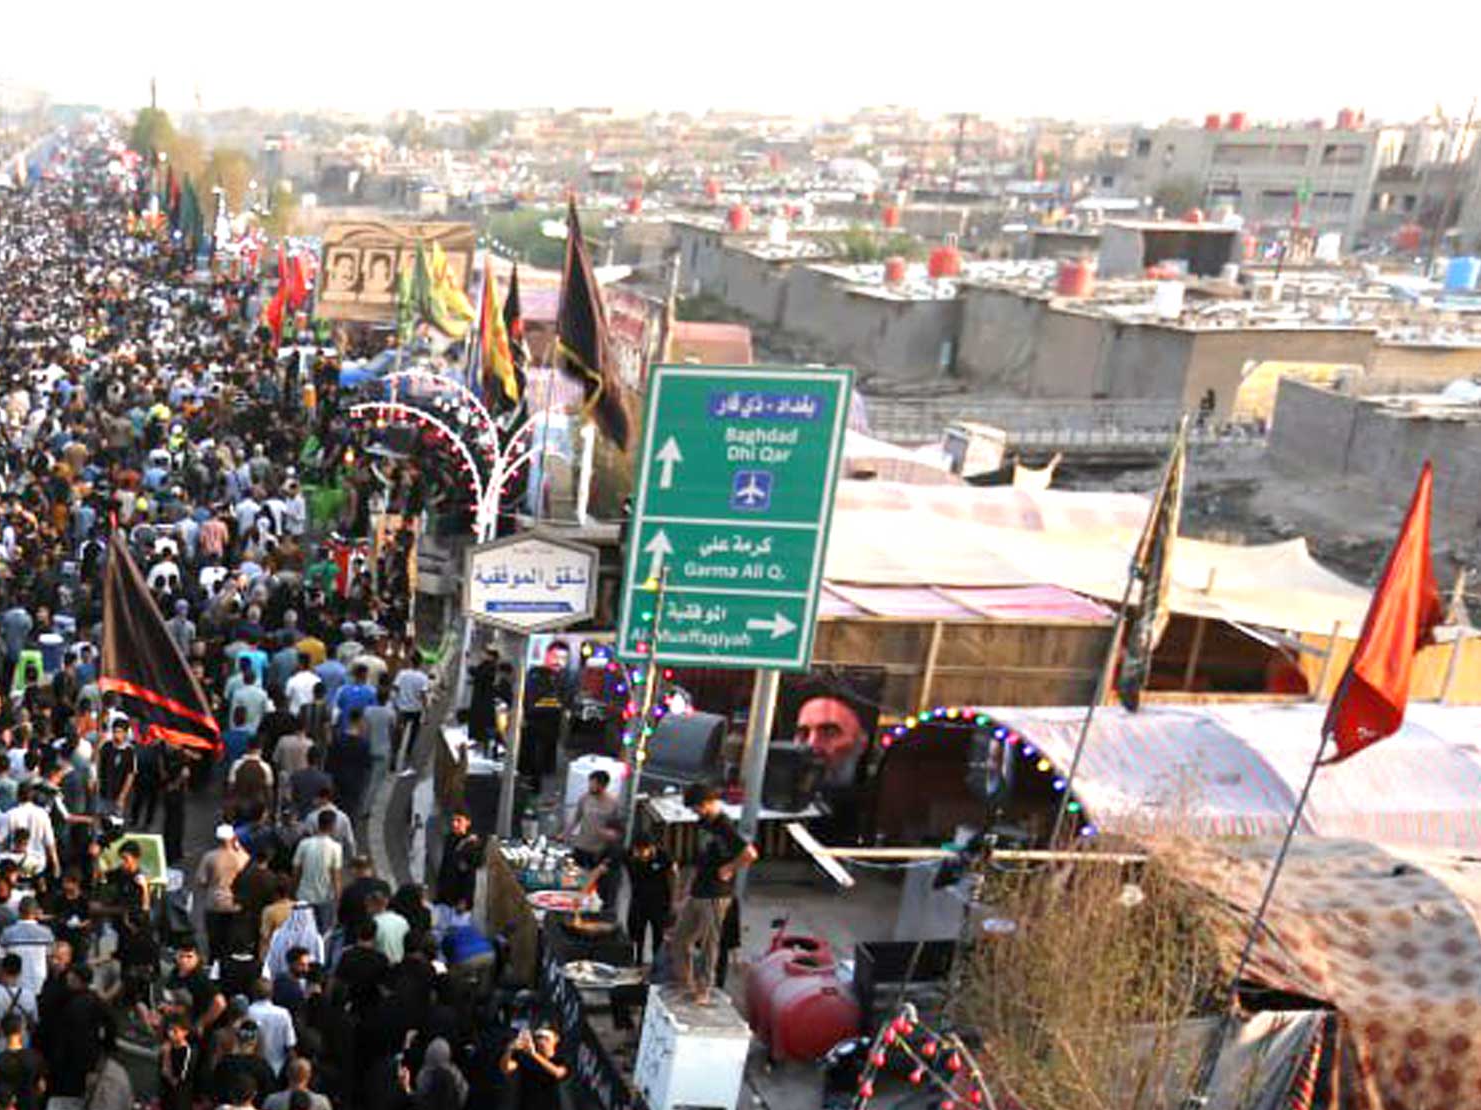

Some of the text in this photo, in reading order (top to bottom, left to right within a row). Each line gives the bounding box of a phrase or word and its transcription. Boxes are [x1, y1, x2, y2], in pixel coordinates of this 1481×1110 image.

[725, 427, 798, 445] Baghdad
[727, 446, 791, 462] Dhi Qar
[684, 560, 738, 578] Garma
[741, 563, 764, 579] Ali
